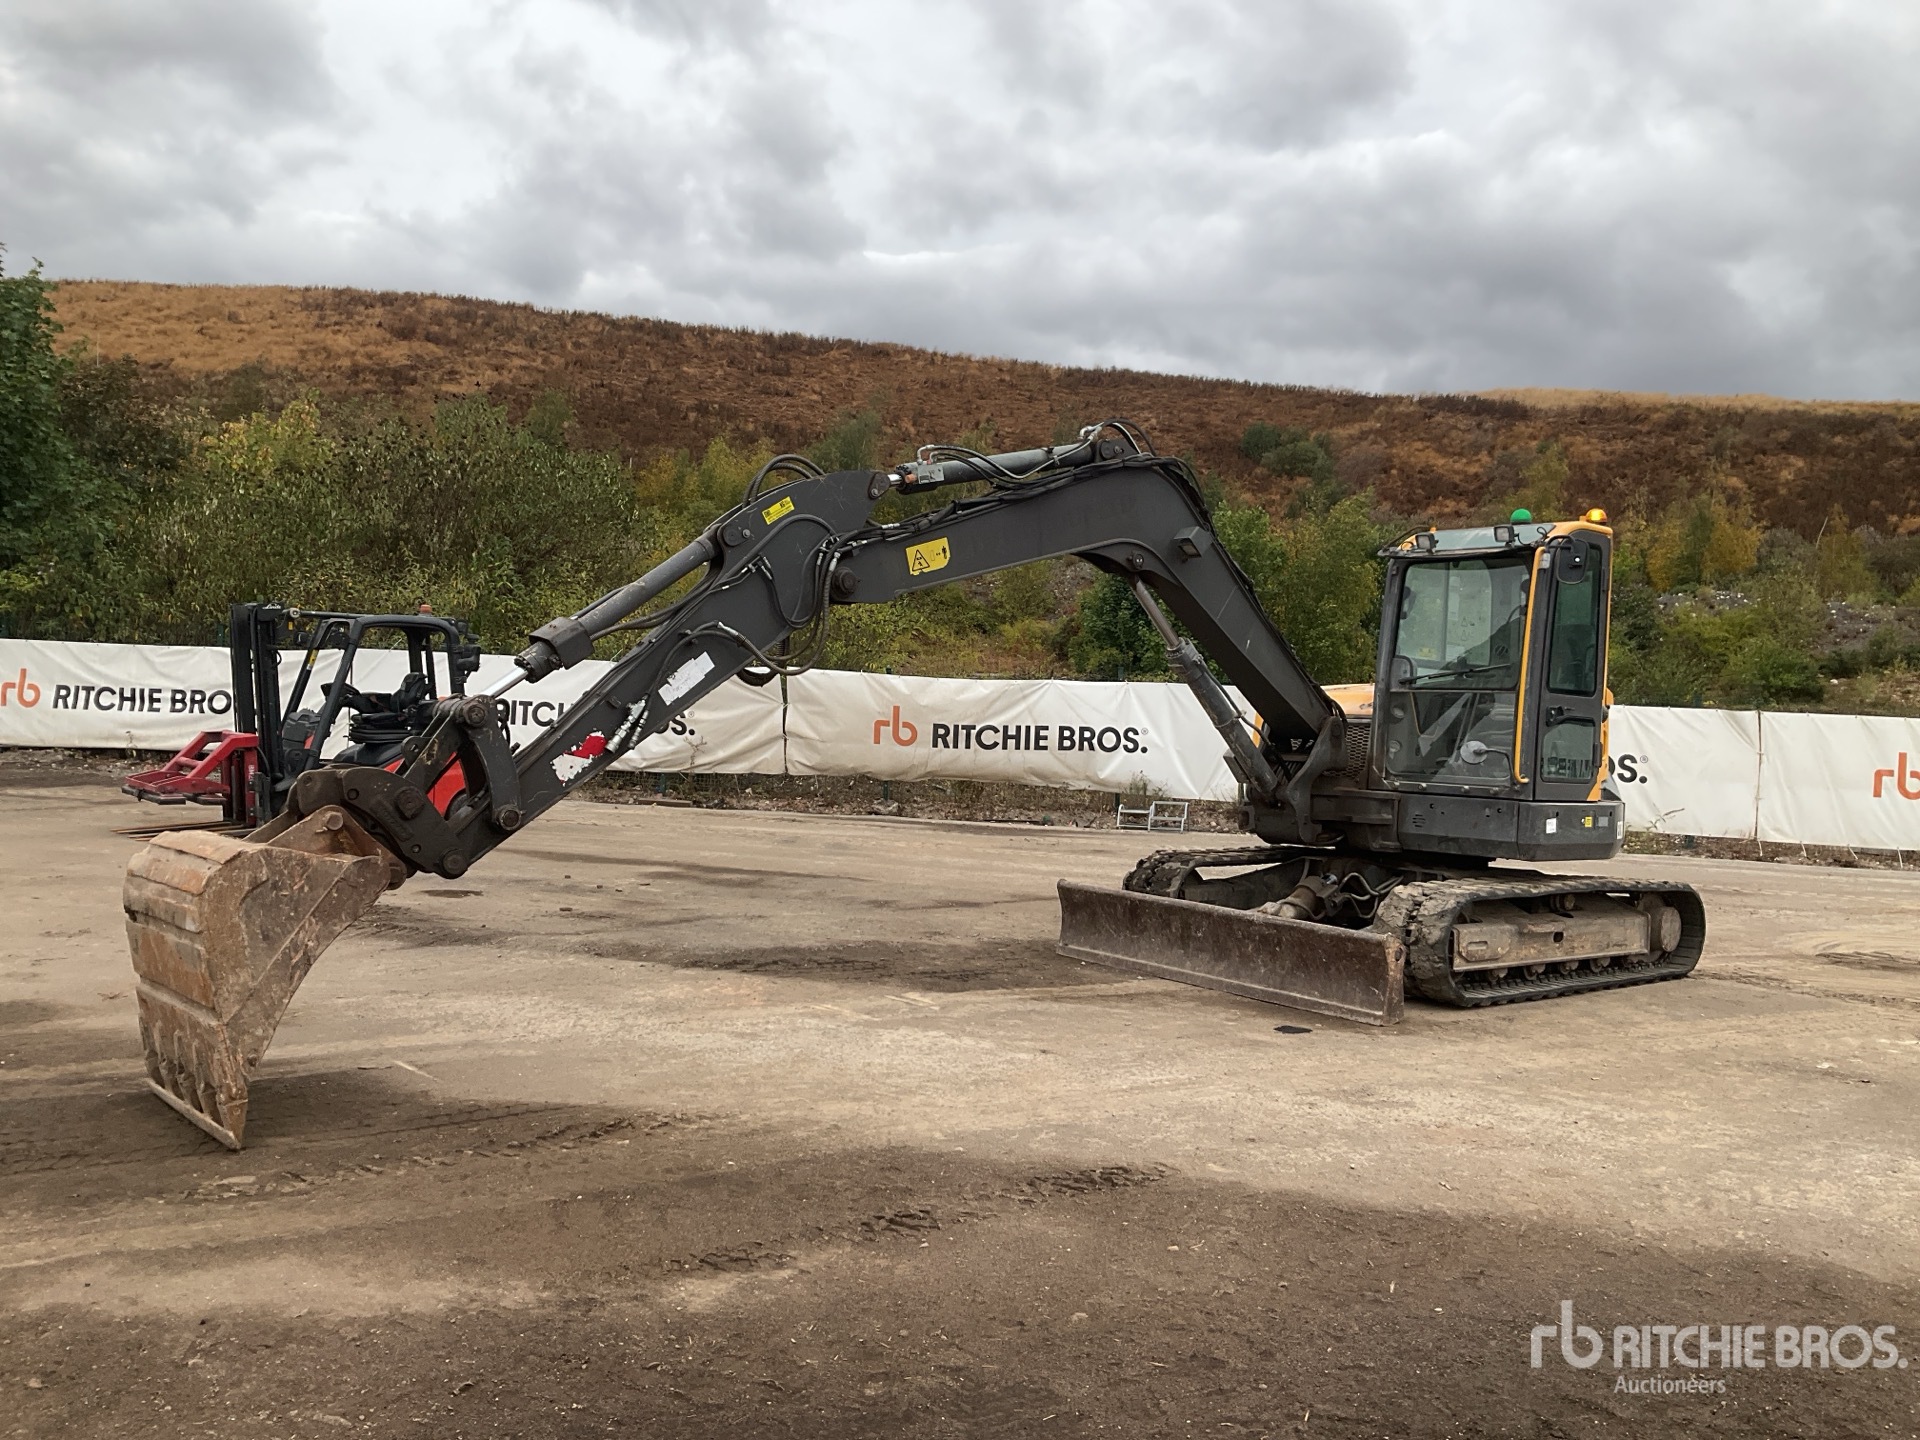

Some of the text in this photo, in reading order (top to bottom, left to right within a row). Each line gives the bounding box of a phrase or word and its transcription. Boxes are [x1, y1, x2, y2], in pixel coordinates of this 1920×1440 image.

[1, 668, 41, 708] rb
[52, 684, 162, 713] RITCHIE
[873, 705, 1149, 754] rb RITCHIE BROS.
